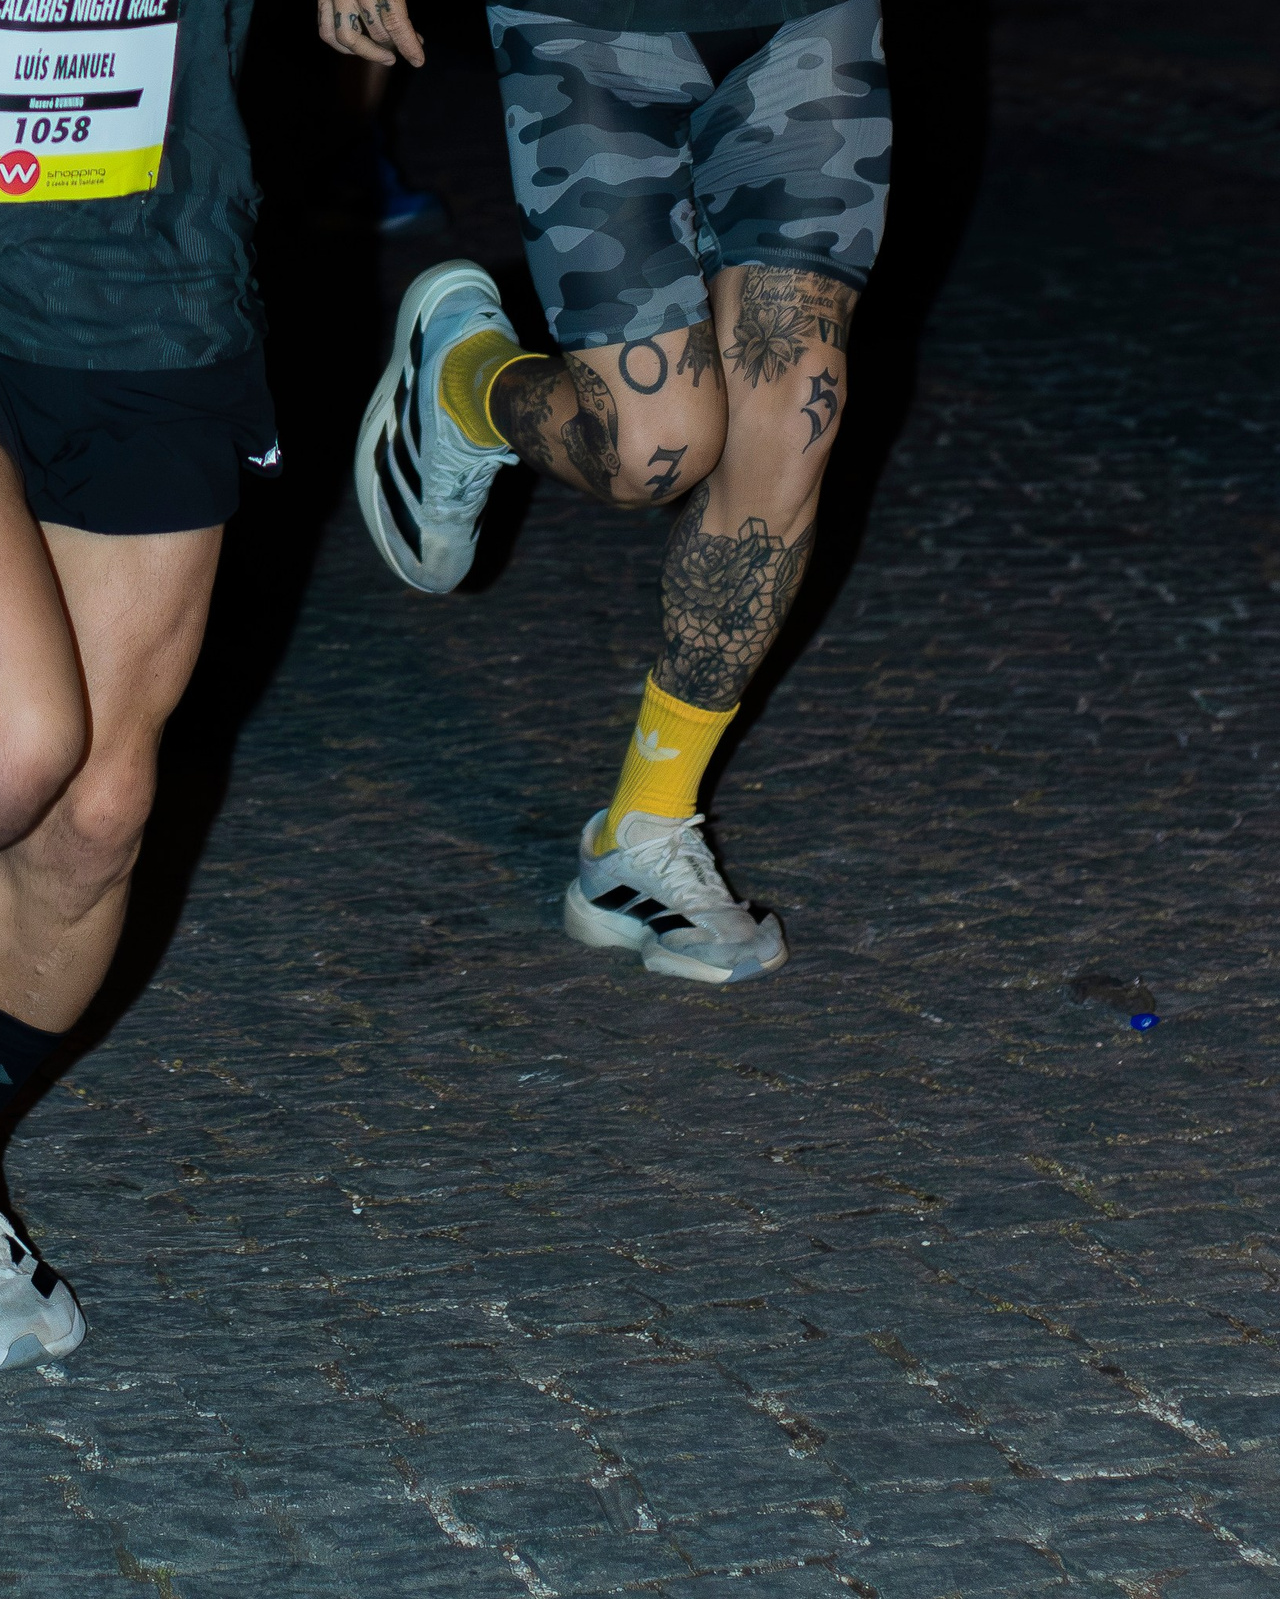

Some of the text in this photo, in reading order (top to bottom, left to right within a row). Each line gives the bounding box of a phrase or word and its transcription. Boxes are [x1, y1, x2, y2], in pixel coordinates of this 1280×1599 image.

[14, 48, 115, 81] LUÍS MANUEL
[14, 116, 91, 145] 1058
[47, 168, 106, 178] shopping
